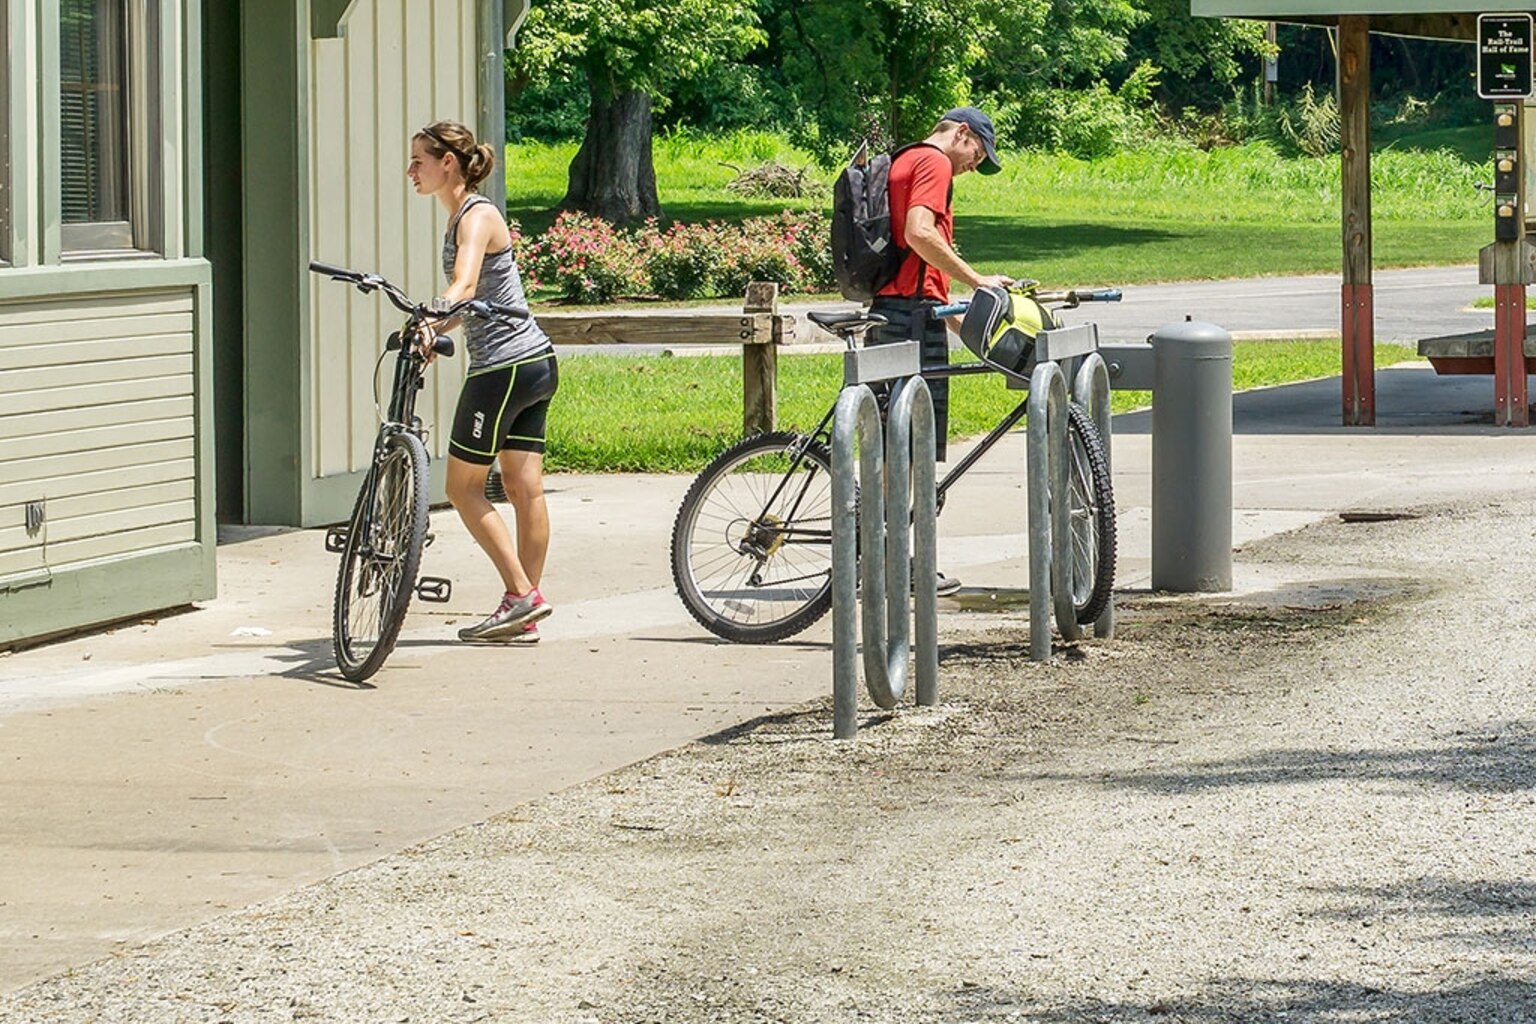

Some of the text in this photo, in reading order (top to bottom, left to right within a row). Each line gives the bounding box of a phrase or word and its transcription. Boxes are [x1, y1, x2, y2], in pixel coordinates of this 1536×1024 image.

[1482, 45, 1529, 54] Hall of Fame
